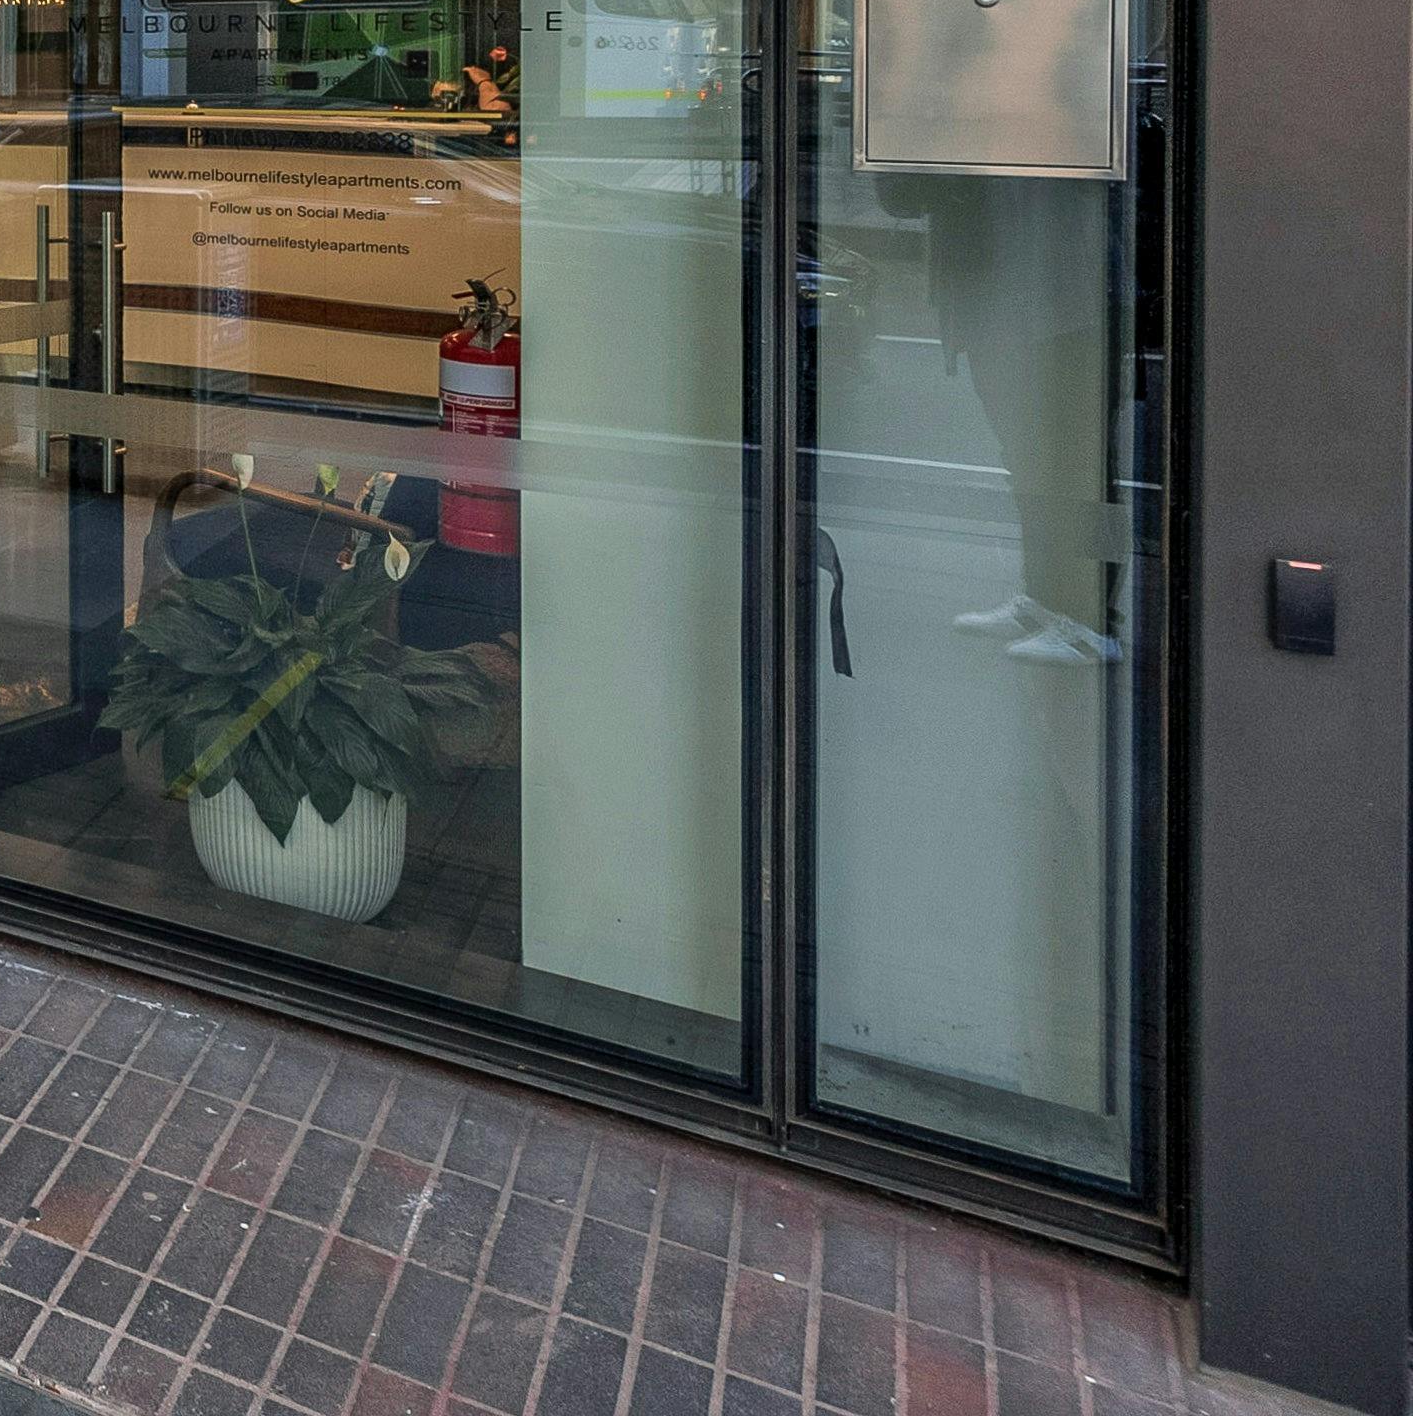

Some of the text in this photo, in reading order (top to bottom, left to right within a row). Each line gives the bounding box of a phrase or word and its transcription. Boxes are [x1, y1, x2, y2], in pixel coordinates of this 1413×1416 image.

[68, 10, 563, 35] MELBOURNE LIFESTYLE
[148, 167, 462, 191] www.melbournelifestyleapartments.com
[209, 201, 252, 215] Follow
[256, 206, 272, 217] us
[276, 207, 293, 218] on
[297, 205, 338, 220] Social
[192, 232, 410, 255] @melbournelifestyleapartments
